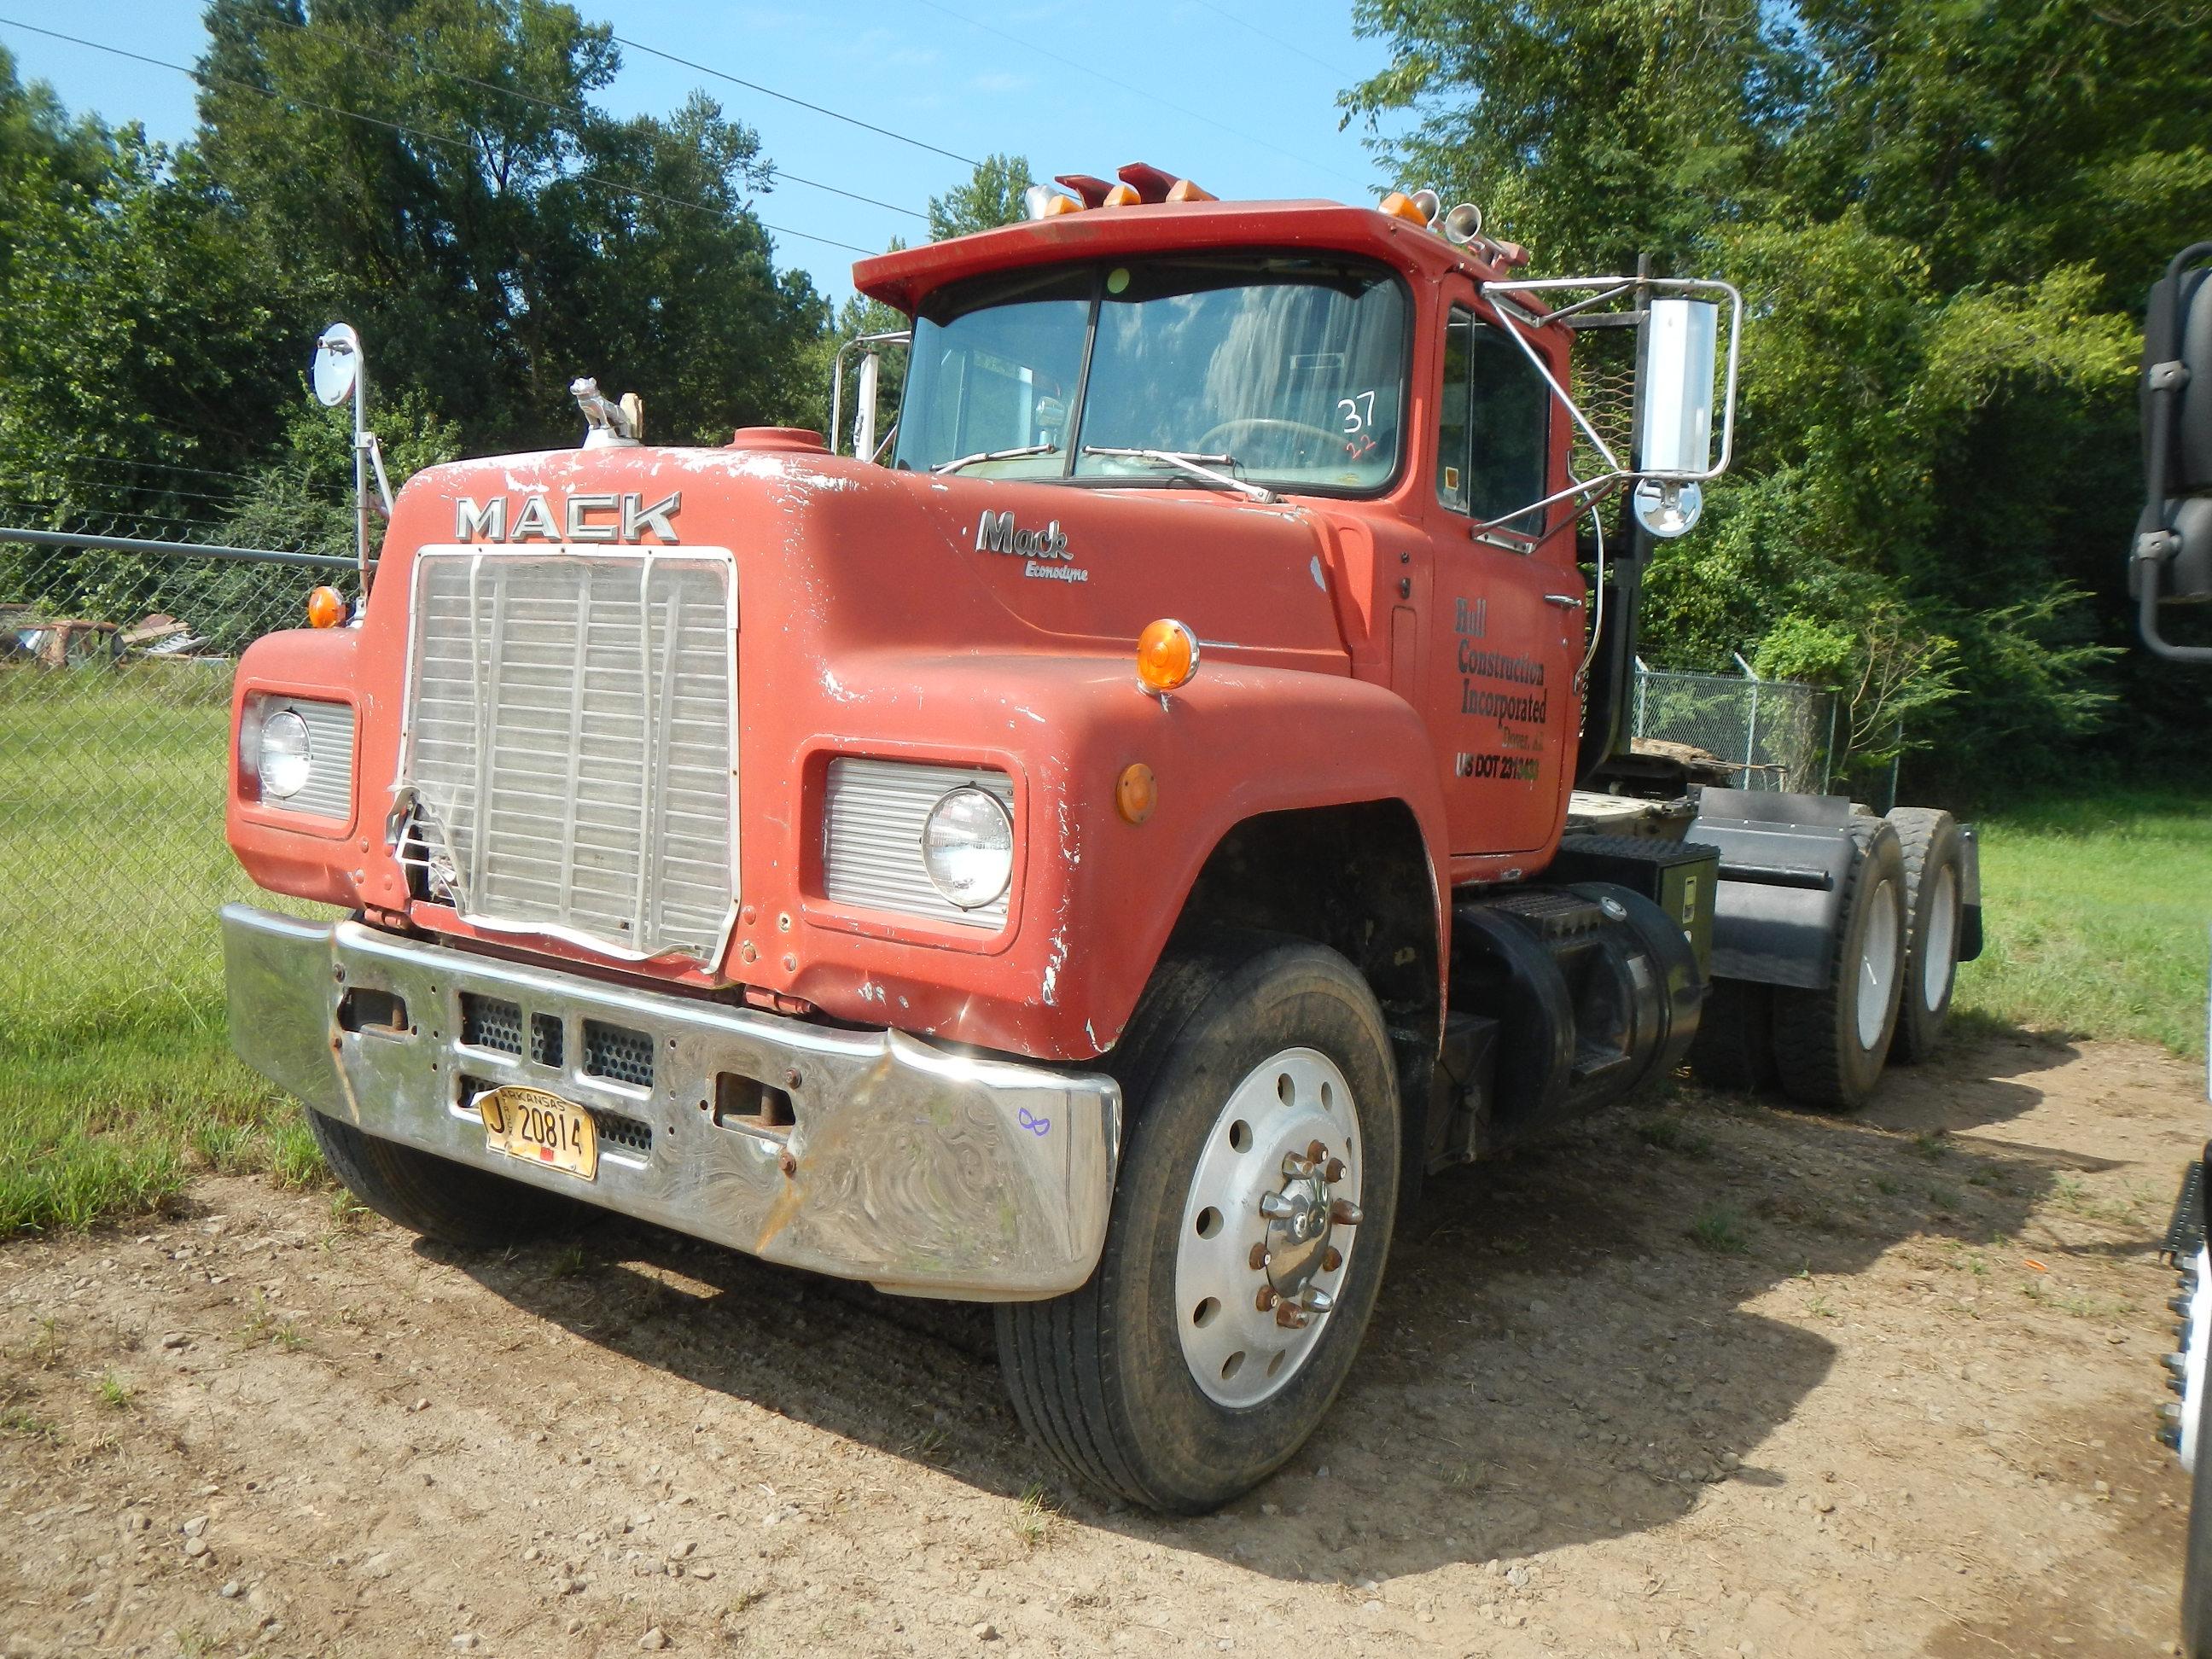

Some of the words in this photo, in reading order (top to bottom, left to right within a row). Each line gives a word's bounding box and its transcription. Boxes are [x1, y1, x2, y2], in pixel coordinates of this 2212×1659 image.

[1337, 390, 1376, 434] 37
[1346, 434, 1377, 460] 22
[455, 492, 682, 544] MACK
[975, 509, 1074, 561] Mack
[1025, 560, 1089, 584] Econodyne
[1458, 638, 1544, 686] Construction
[1461, 678, 1547, 729] Incorporated
[1475, 754, 1500, 778] DOT
[500, 1090, 566, 1111] ARKANSAS
[490, 1097, 504, 1133] J
[518, 1104, 582, 1156] 20814
